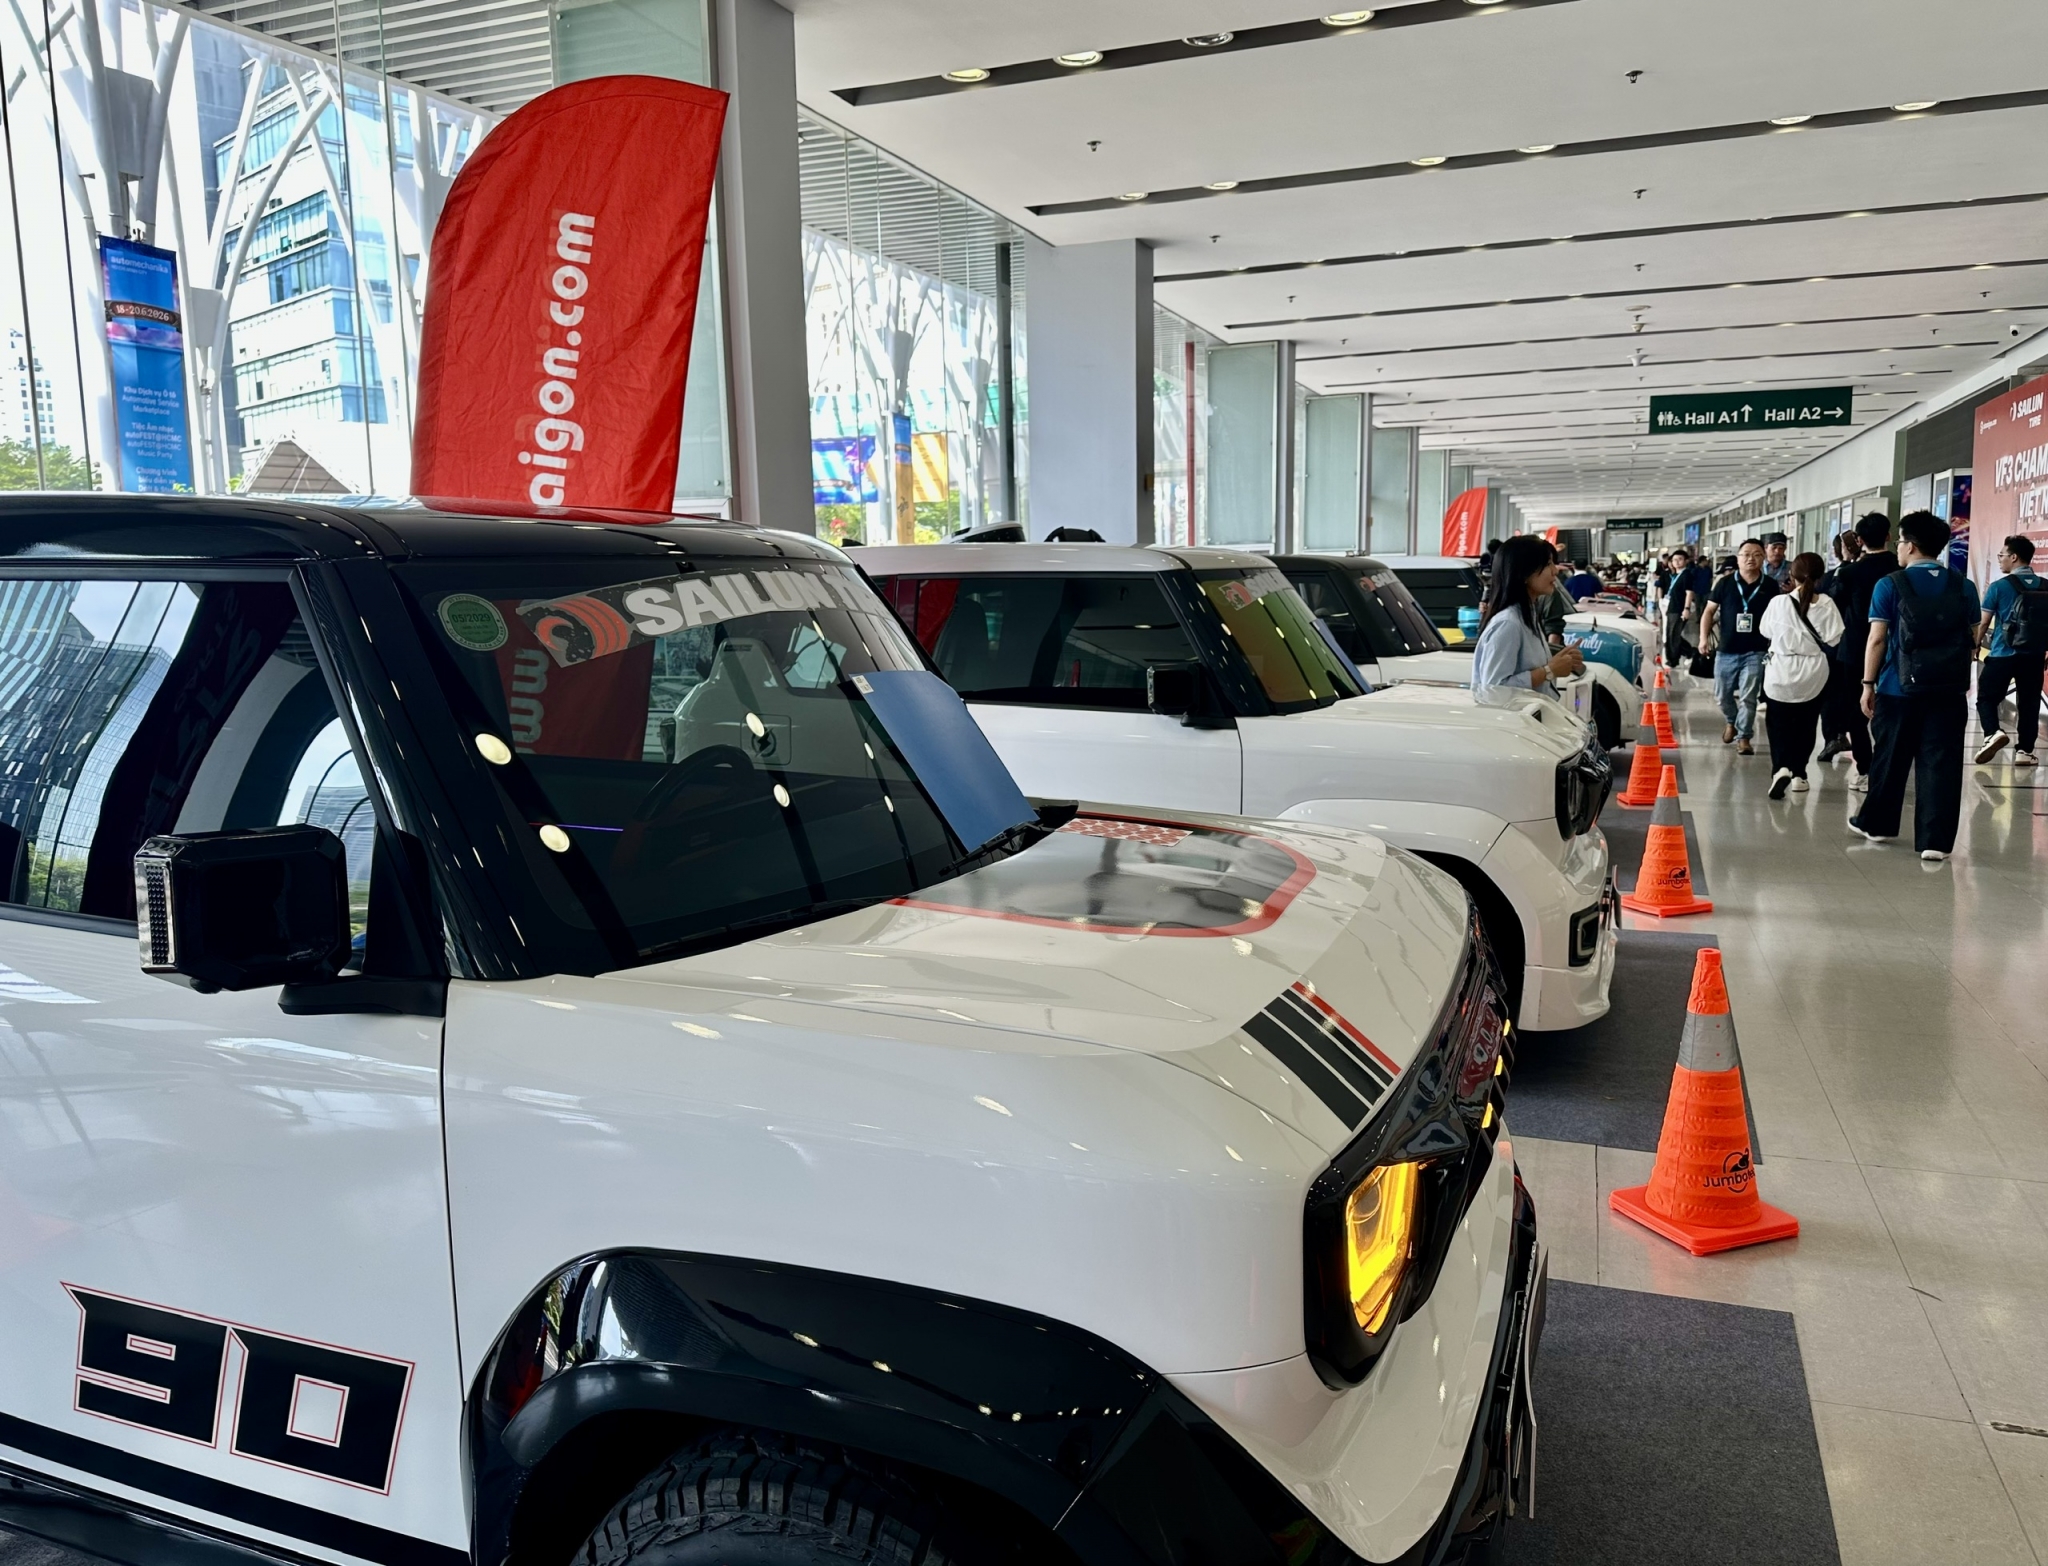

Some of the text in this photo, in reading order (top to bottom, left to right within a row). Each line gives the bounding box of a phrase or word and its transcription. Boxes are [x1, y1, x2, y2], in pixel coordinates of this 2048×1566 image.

[110, 256, 169, 274] automechanika
[518, 212, 596, 508] aigon.com
[1684, 407, 1821, 425] Hall A1 Hall A2
[2017, 392, 2044, 418] SAILUN
[2029, 414, 2042, 428] TIRE
[1995, 455, 2014, 488] VF3
[624, 570, 838, 636] SAILUN
[451, 613, 491, 623] 05/2029
[60, 1280, 416, 1497] 90
